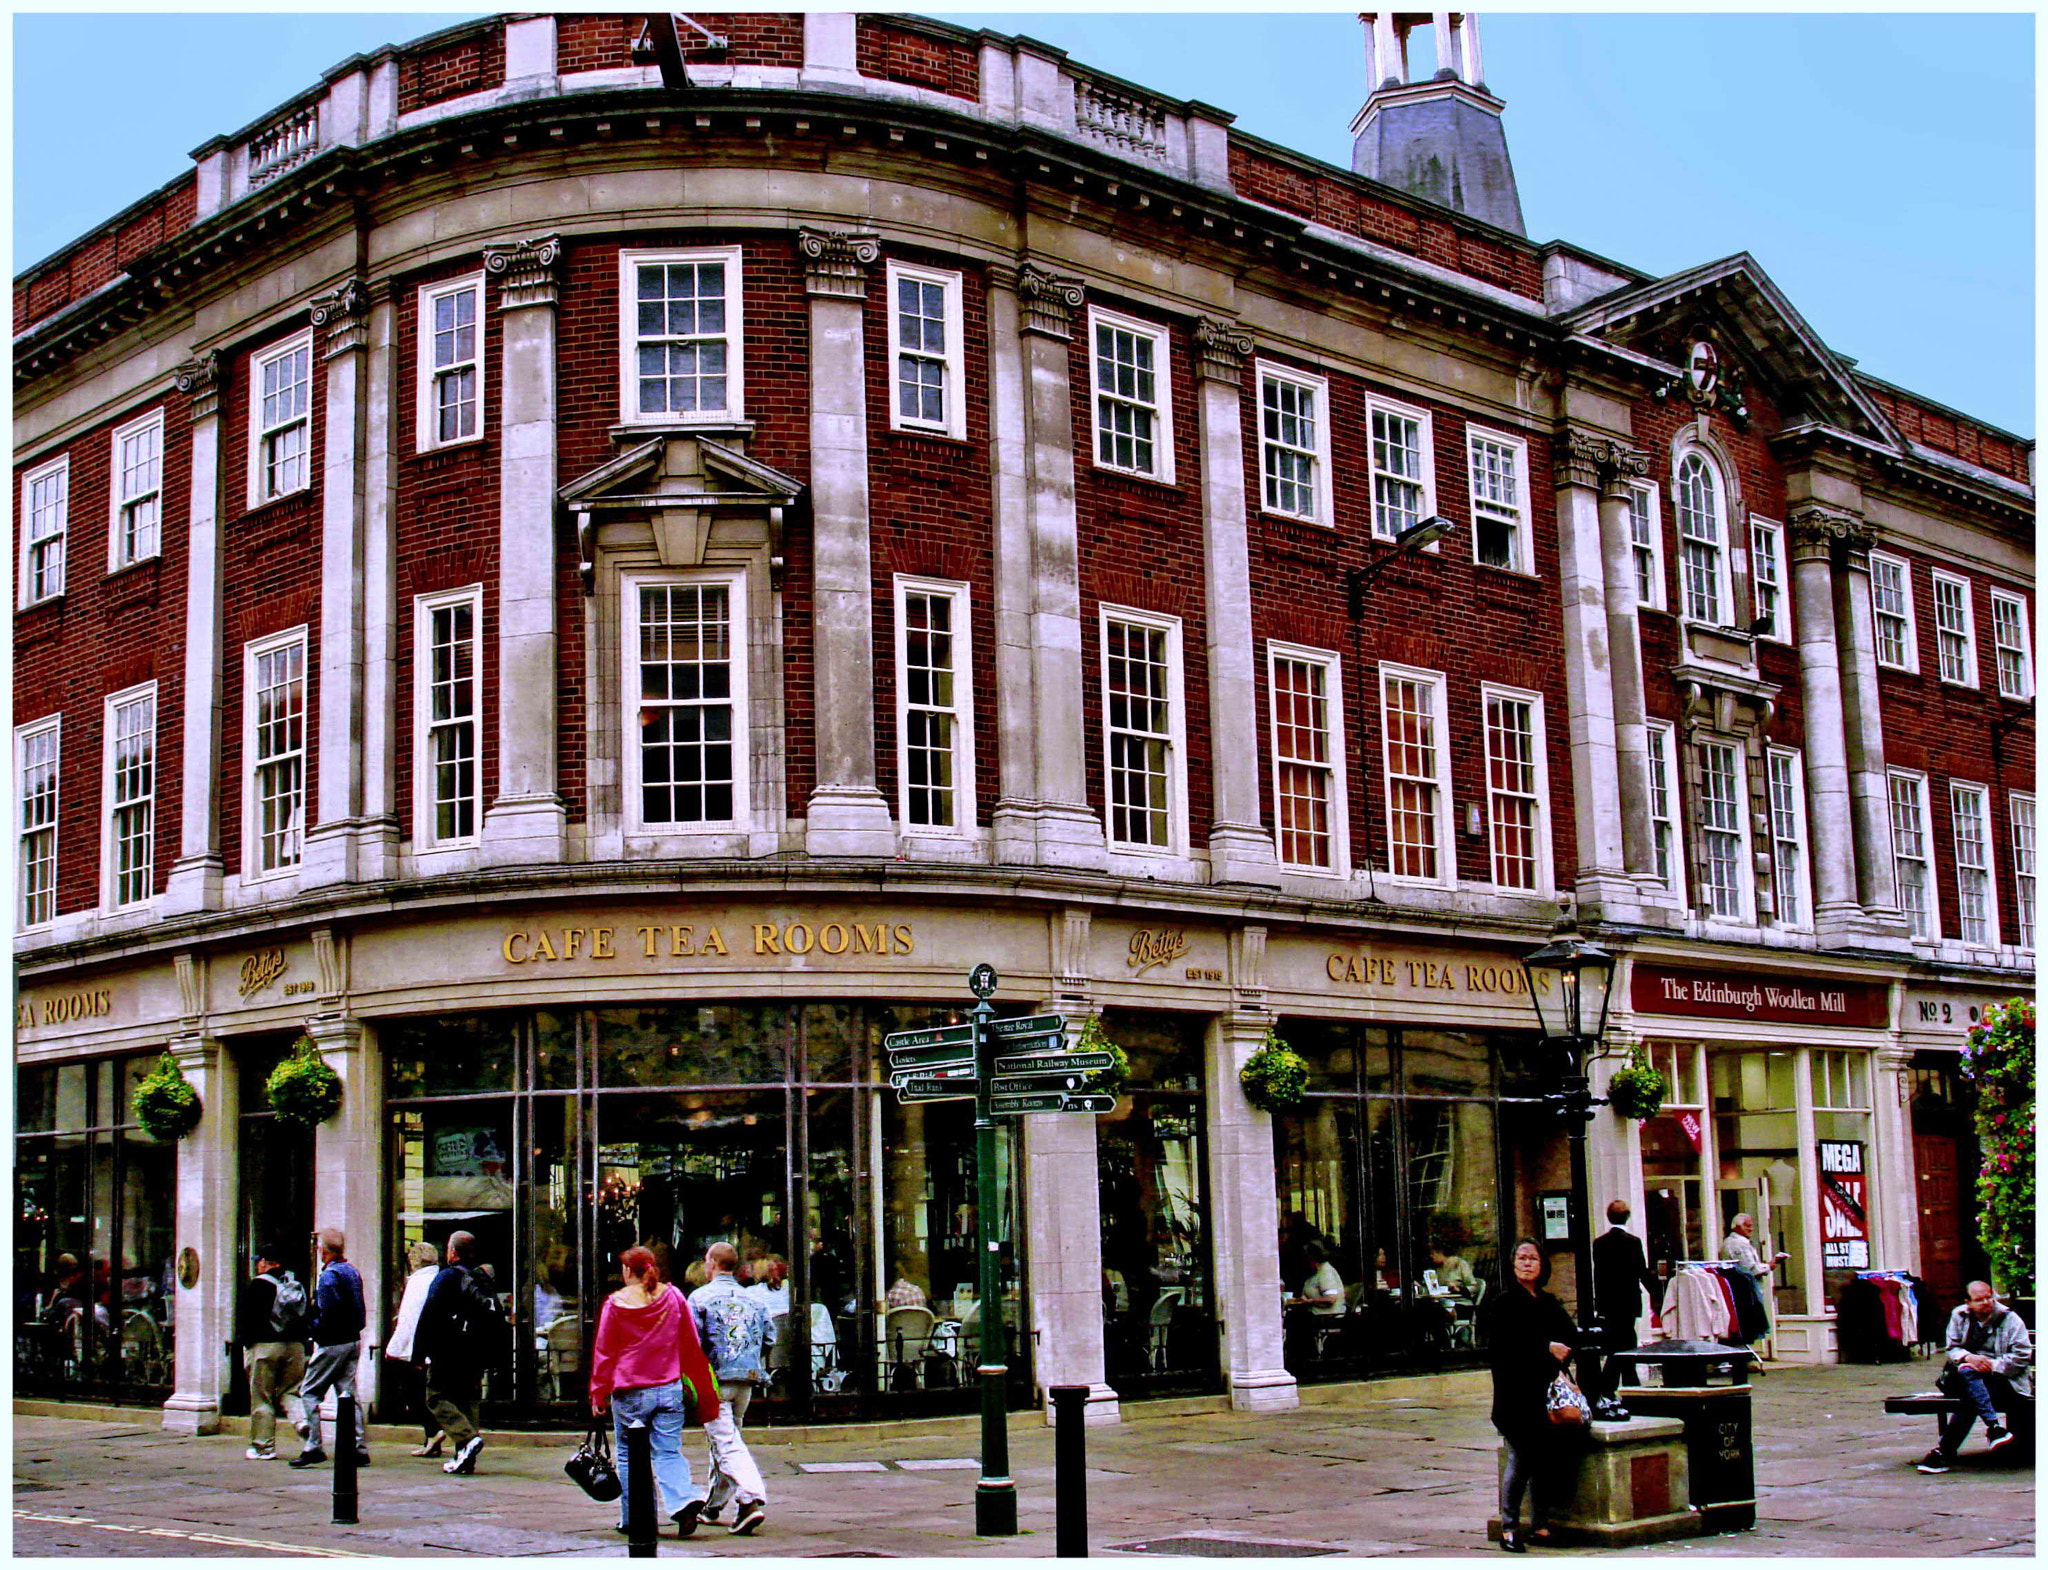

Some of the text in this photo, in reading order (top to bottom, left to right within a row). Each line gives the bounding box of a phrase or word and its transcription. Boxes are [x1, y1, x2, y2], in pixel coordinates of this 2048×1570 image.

[502, 923, 915, 963] CAFE TEA ROOMS
[1128, 928, 1191, 978] Bettys
[238, 949, 288, 1004] Bettys
[1186, 967, 1202, 979] EST
[1326, 954, 1396, 985] CAFE
[1406, 960, 1456, 990] TEA
[1661, 977, 1846, 1012] The Edinburgh Woollen Mill
[44, 990, 110, 1025] ROOMS
[1942, 1003, 1953, 1024] 2
[1015, 1020, 1033, 1031] Royal
[912, 1035, 930, 1044] Area
[999, 1057, 1107, 1070] National Railway Museum
[993, 1081, 1033, 1092] Post Office
[1022, 1099, 1043, 1108] Rooms
[1821, 1143, 1861, 1172] MEGA
[1825, 1242, 1839, 1255] ALL
[1826, 1255, 1850, 1268] MUST
[1719, 1422, 1738, 1435] CITY
[1723, 1436, 1735, 1447] OF
